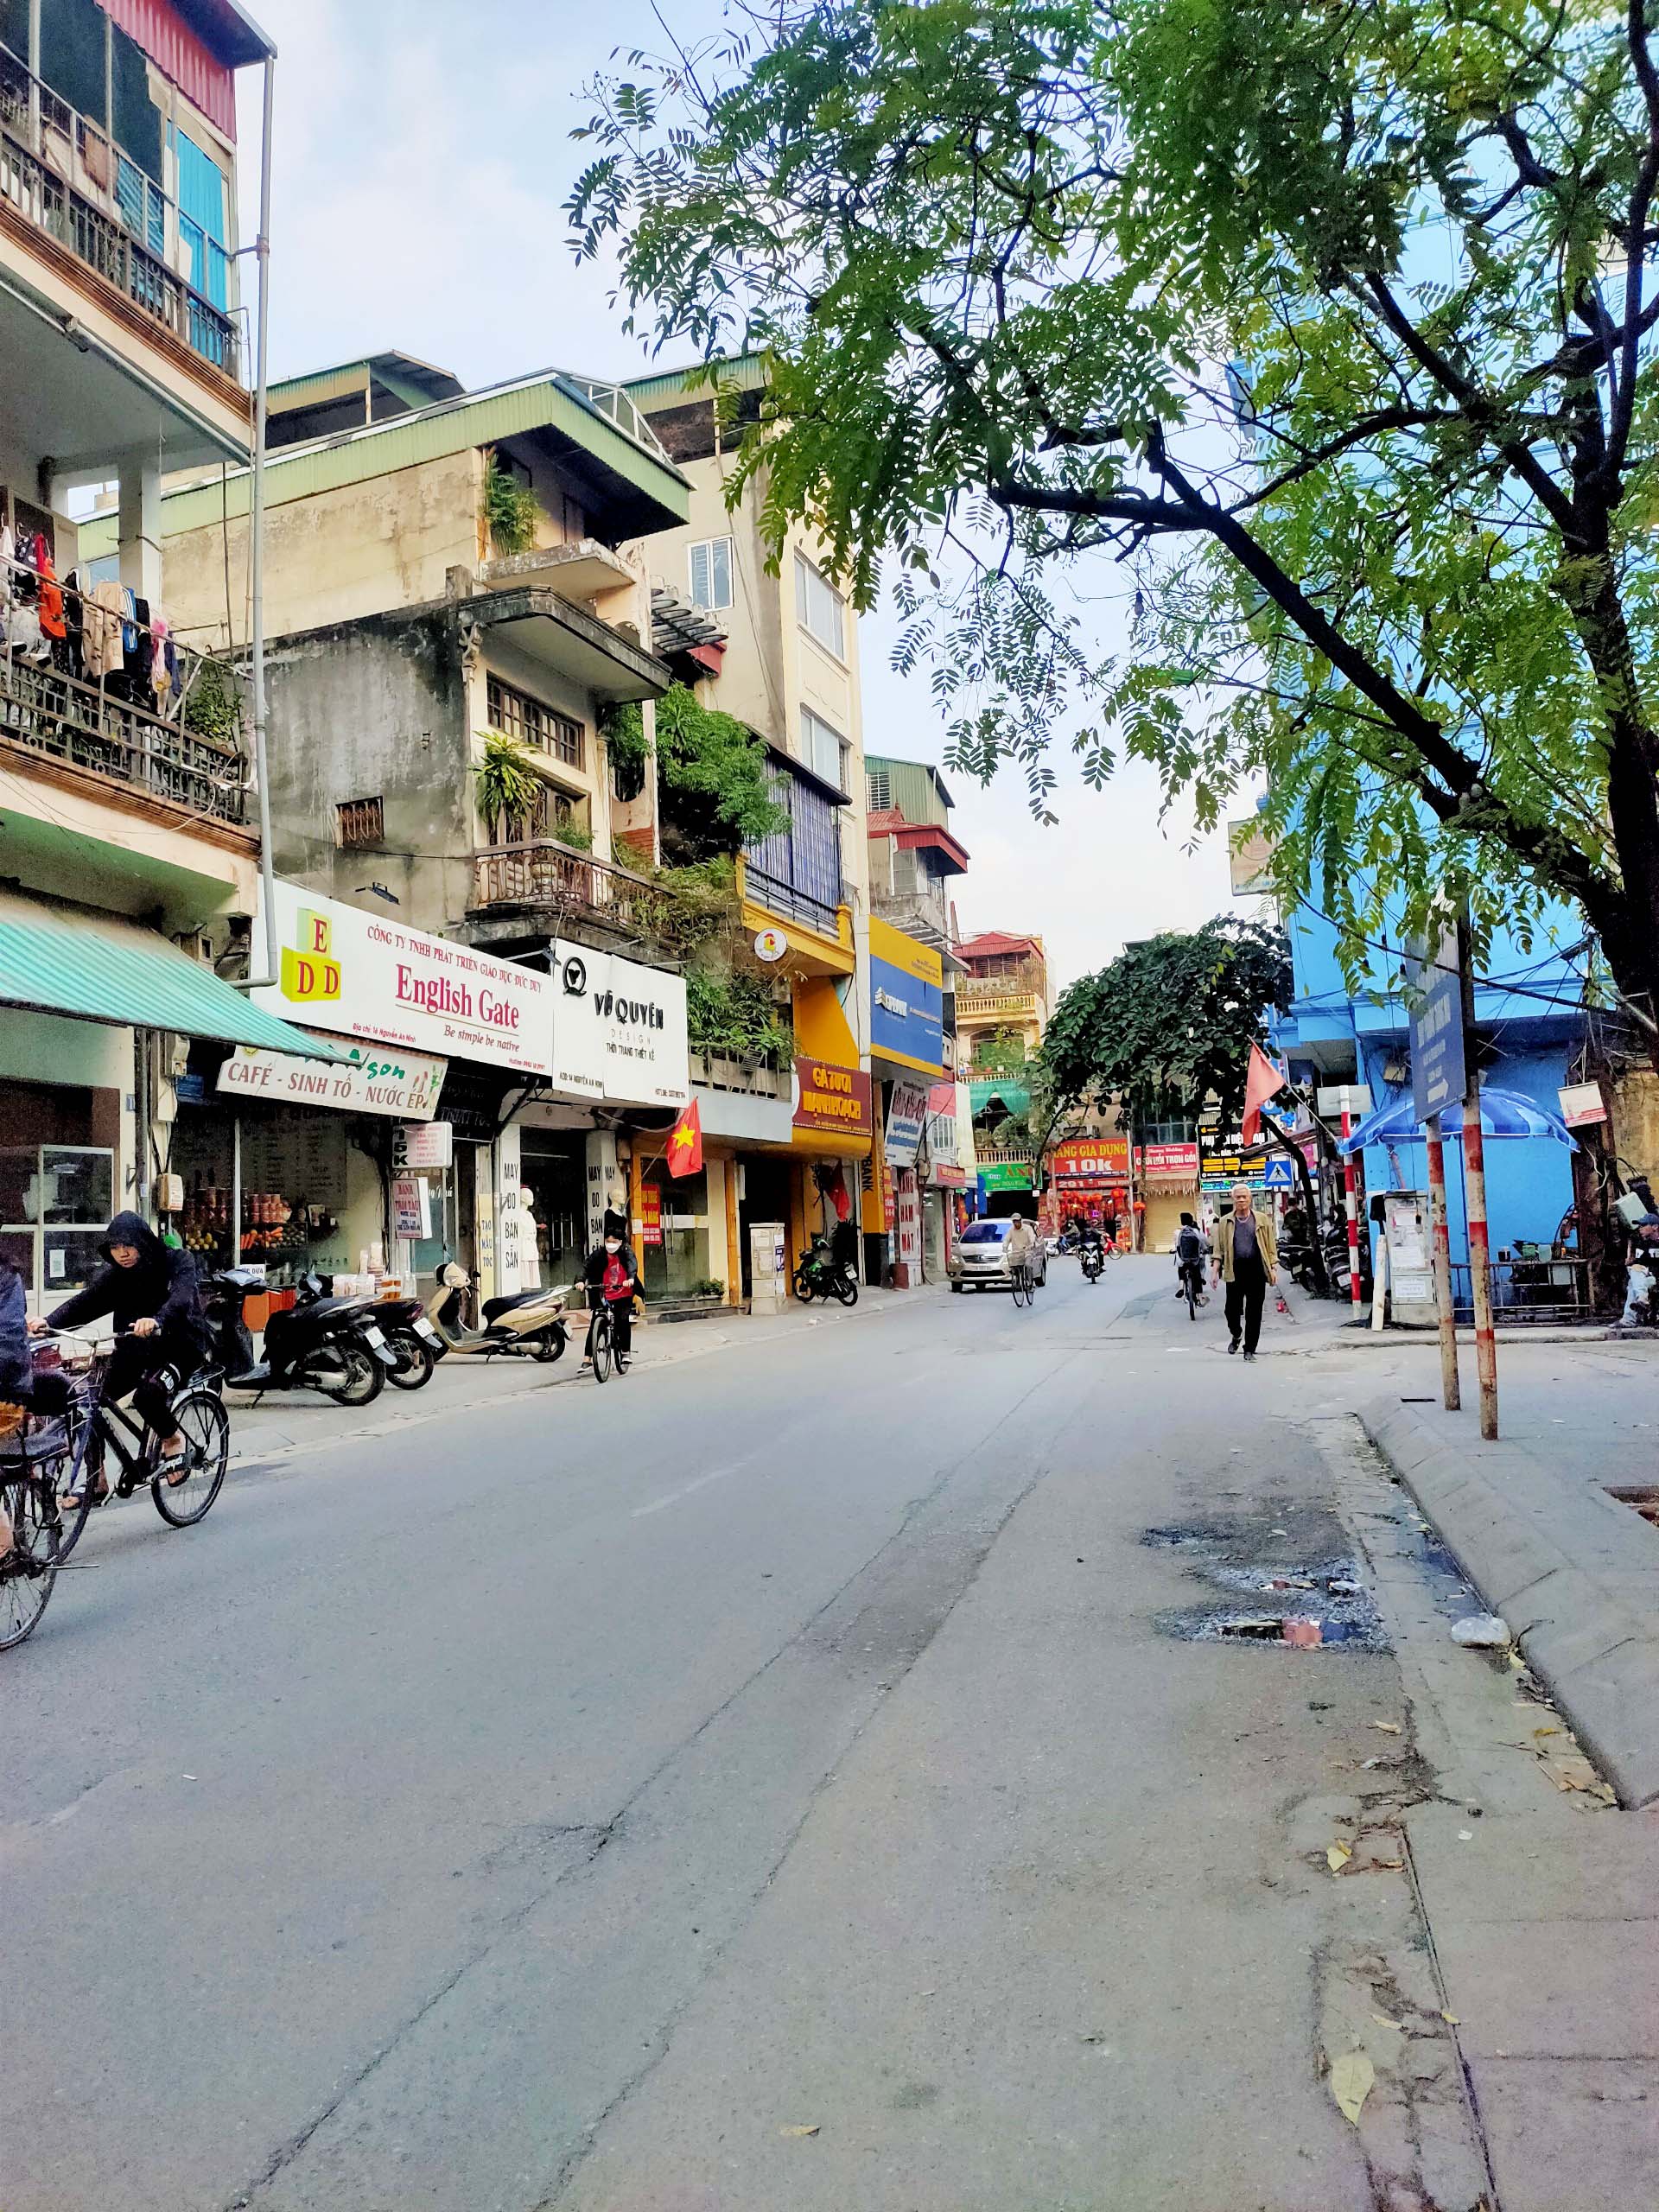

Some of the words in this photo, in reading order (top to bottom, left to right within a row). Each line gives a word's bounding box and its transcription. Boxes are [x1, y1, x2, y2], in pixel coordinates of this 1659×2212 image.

[313, 918, 327, 953] E
[367, 924, 392, 945] CÔNG
[395, 934, 405, 950] TY
[410, 938, 431, 957] TNHH
[297, 960, 315, 995] D
[324, 964, 339, 995] D
[395, 963, 473, 1018] English
[479, 988, 520, 1029] Gate
[614, 997, 664, 1030] QUYÊN
[443, 1024, 456, 1039] Be
[457, 1028, 485, 1046] simple
[485, 1034, 495, 1046] be
[496, 1039, 520, 1052] native
[227, 1062, 272, 1086] CAFÉ
[288, 1072, 327, 1095] SINH
[333, 1072, 352, 1097] TỐ
[1079, 1144, 1097, 1157] GIA
[504, 1163, 518, 1180] MAY
[588, 1166, 601, 1181] MAY
[505, 1219, 518, 1239] BÁN
[590, 1217, 603, 1234] BÁN
